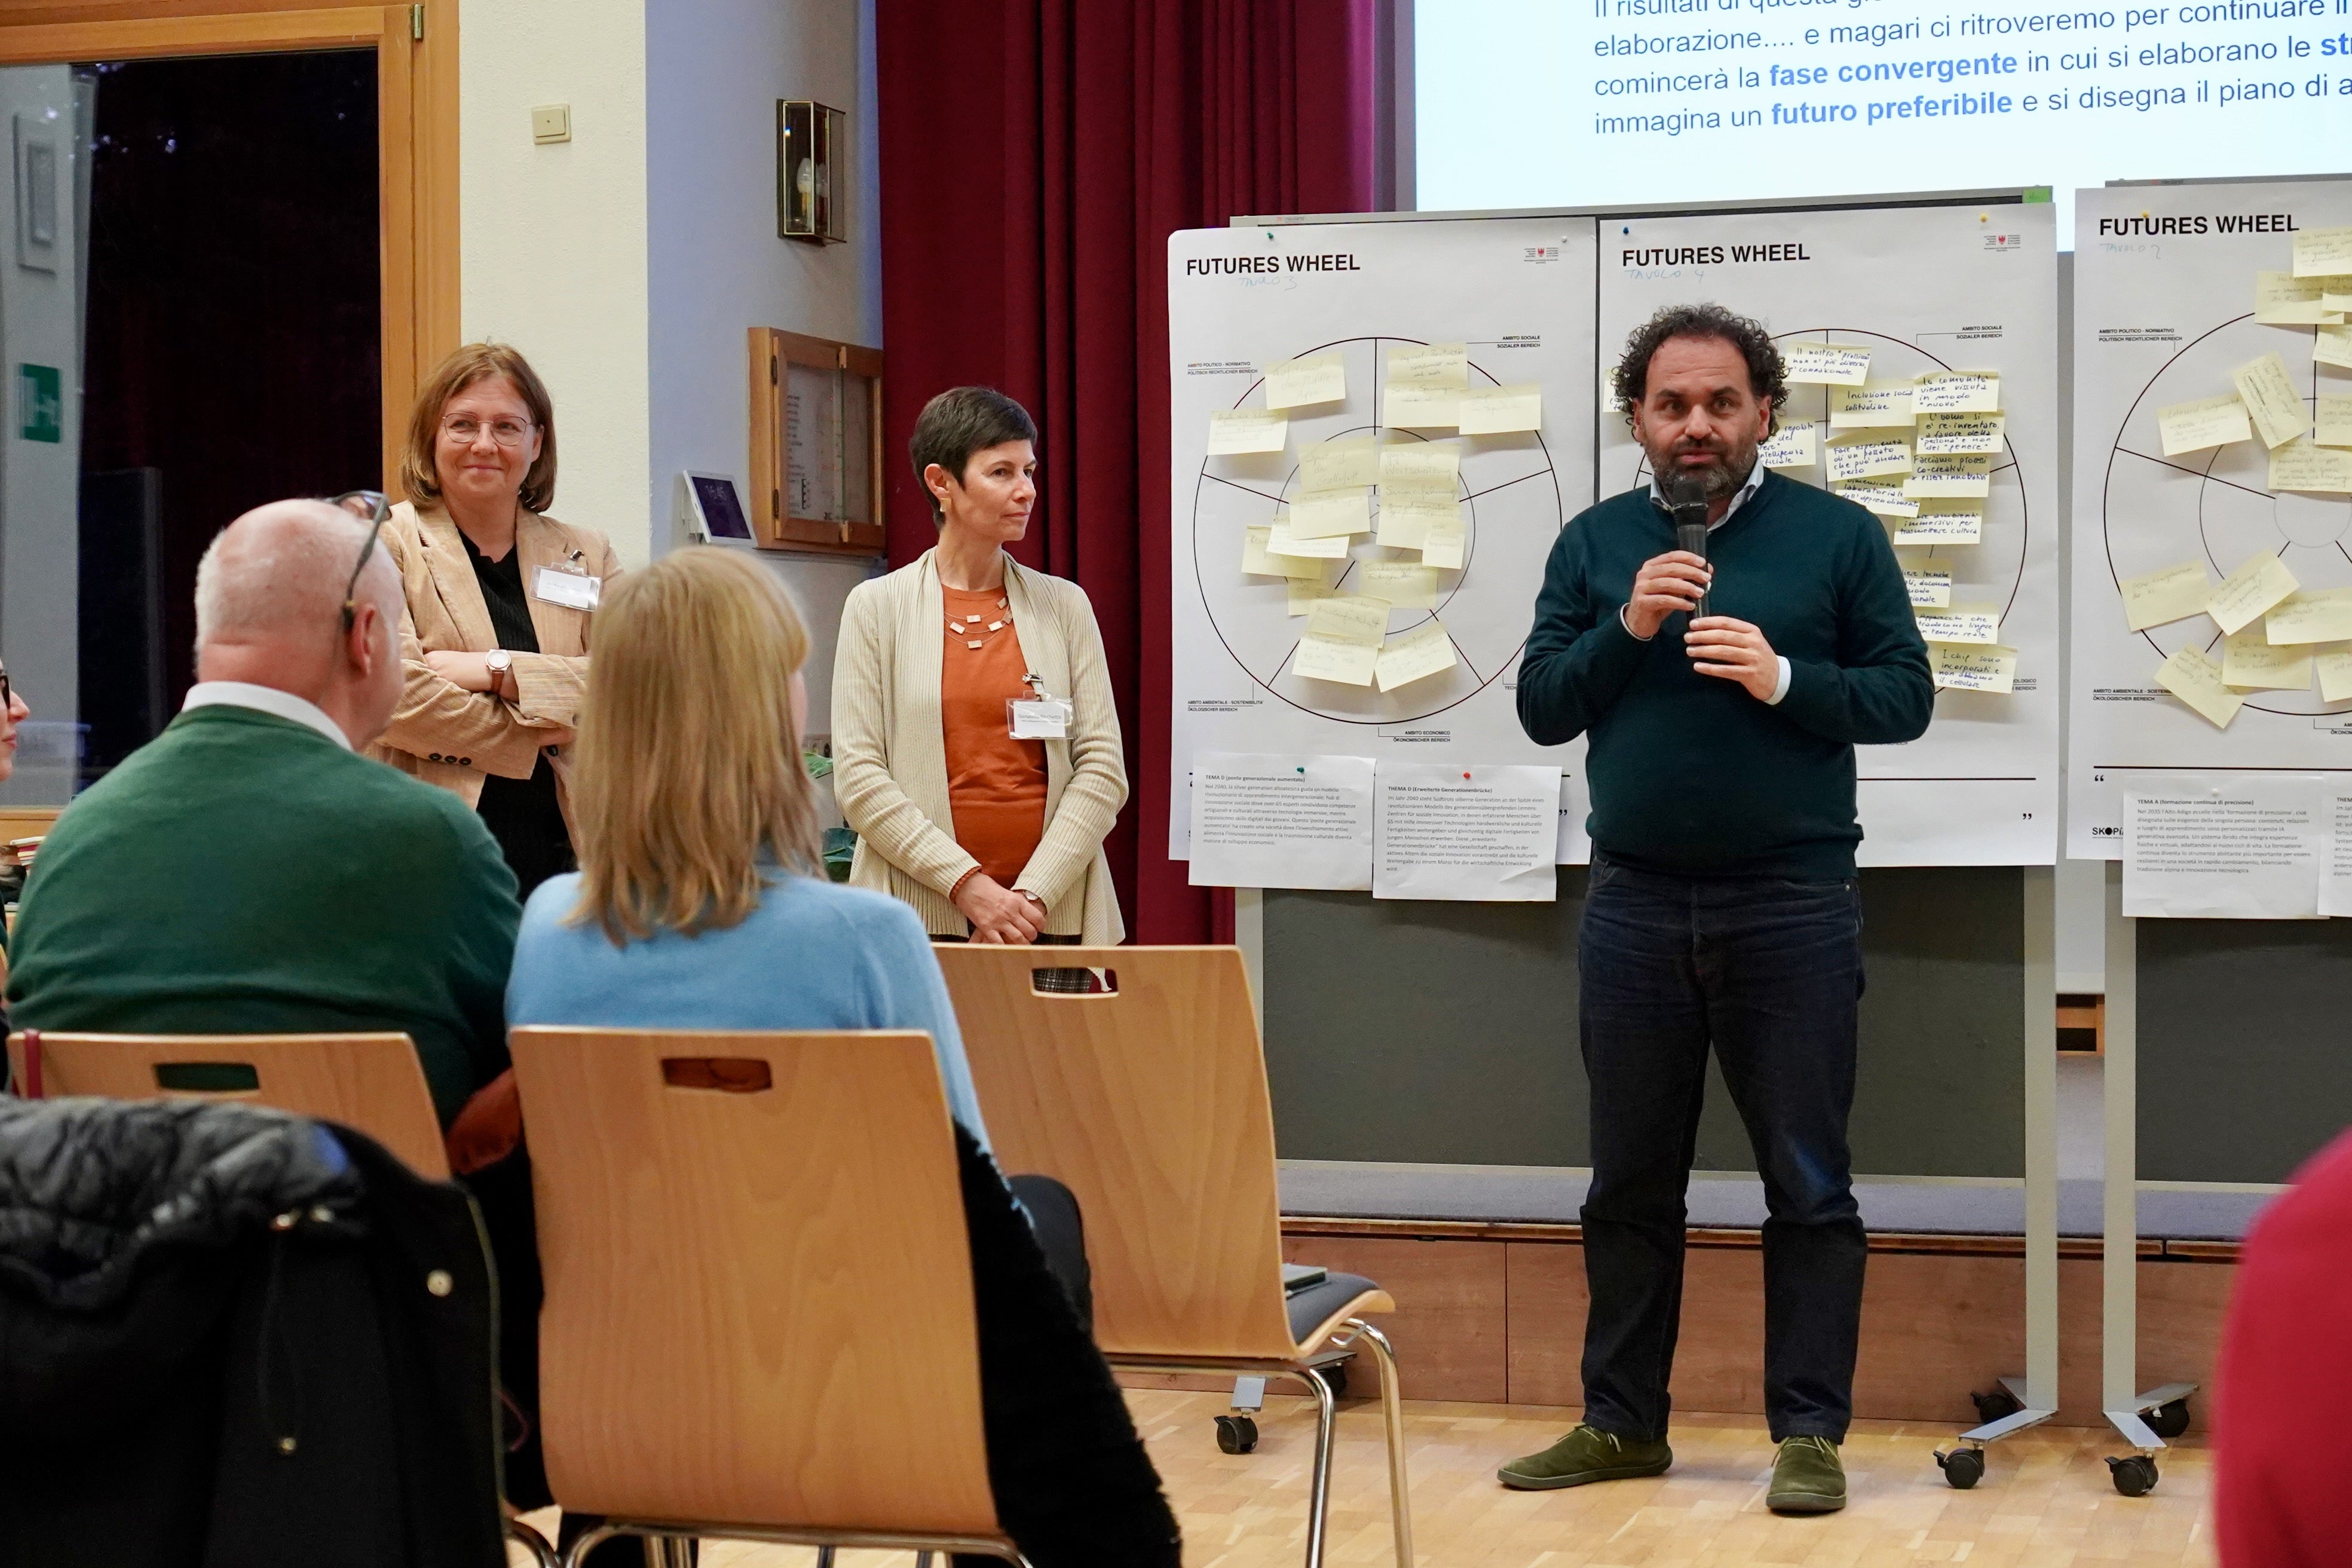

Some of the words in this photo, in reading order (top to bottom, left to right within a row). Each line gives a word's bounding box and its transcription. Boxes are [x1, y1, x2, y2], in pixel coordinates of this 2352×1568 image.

[1805, 29, 1820, 45] e
[1830, 17, 1920, 47] magari
[1931, 16, 1950, 37] ci
[1961, 13, 2115, 36] ritroveremo
[2126, 7, 2170, 32] per
[2179, 0, 2325, 23] continuare
[1595, 68, 1729, 96] comincerà
[1739, 67, 1760, 88] la
[1769, 64, 1829, 87] fase
[1838, 51, 2017, 84] convergente
[2028, 50, 2050, 72] in
[2060, 47, 2098, 71] cui
[2108, 45, 2129, 68] si
[2139, 41, 2278, 66] elaborano
[2288, 35, 2311, 58] le
[1595, 108, 1722, 136] immagina
[1731, 110, 1762, 127] un
[1771, 102, 1858, 125] futuro
[1867, 91, 2013, 126] preferibile
[2023, 96, 2038, 112] e
[2048, 88, 2069, 111] si
[2079, 83, 2186, 112] disegna
[2197, 80, 2208, 103] il
[2219, 78, 2295, 107] piano
[2305, 74, 2328, 97] di
[2099, 216, 2209, 235] FUTURES
[2216, 214, 2299, 233] WHEEL
[2099, 243, 2145, 253] TAVOLO
[1622, 246, 1725, 267] FUTURES
[1731, 243, 1811, 262] WHEEL
[1187, 256, 1280, 275] FUTURES
[1286, 254, 1361, 272] WHEEL
[1624, 269, 1682, 280] TAVOLO
[1694, 269, 1705, 284] 4
[1284, 275, 1297, 291] 3
[1809, 348, 1834, 357] nostro
[1847, 390, 1891, 399] Inclusione
[1935, 392, 1970, 400] modo
[1875, 454, 1906, 463] andare
[1913, 455, 1953, 464] Facciamo
[1840, 468, 1865, 478] perso
[1931, 629, 1959, 638] tempo
[1963, 630, 1987, 638] reale
[1941, 662, 1992, 673] incorporati
